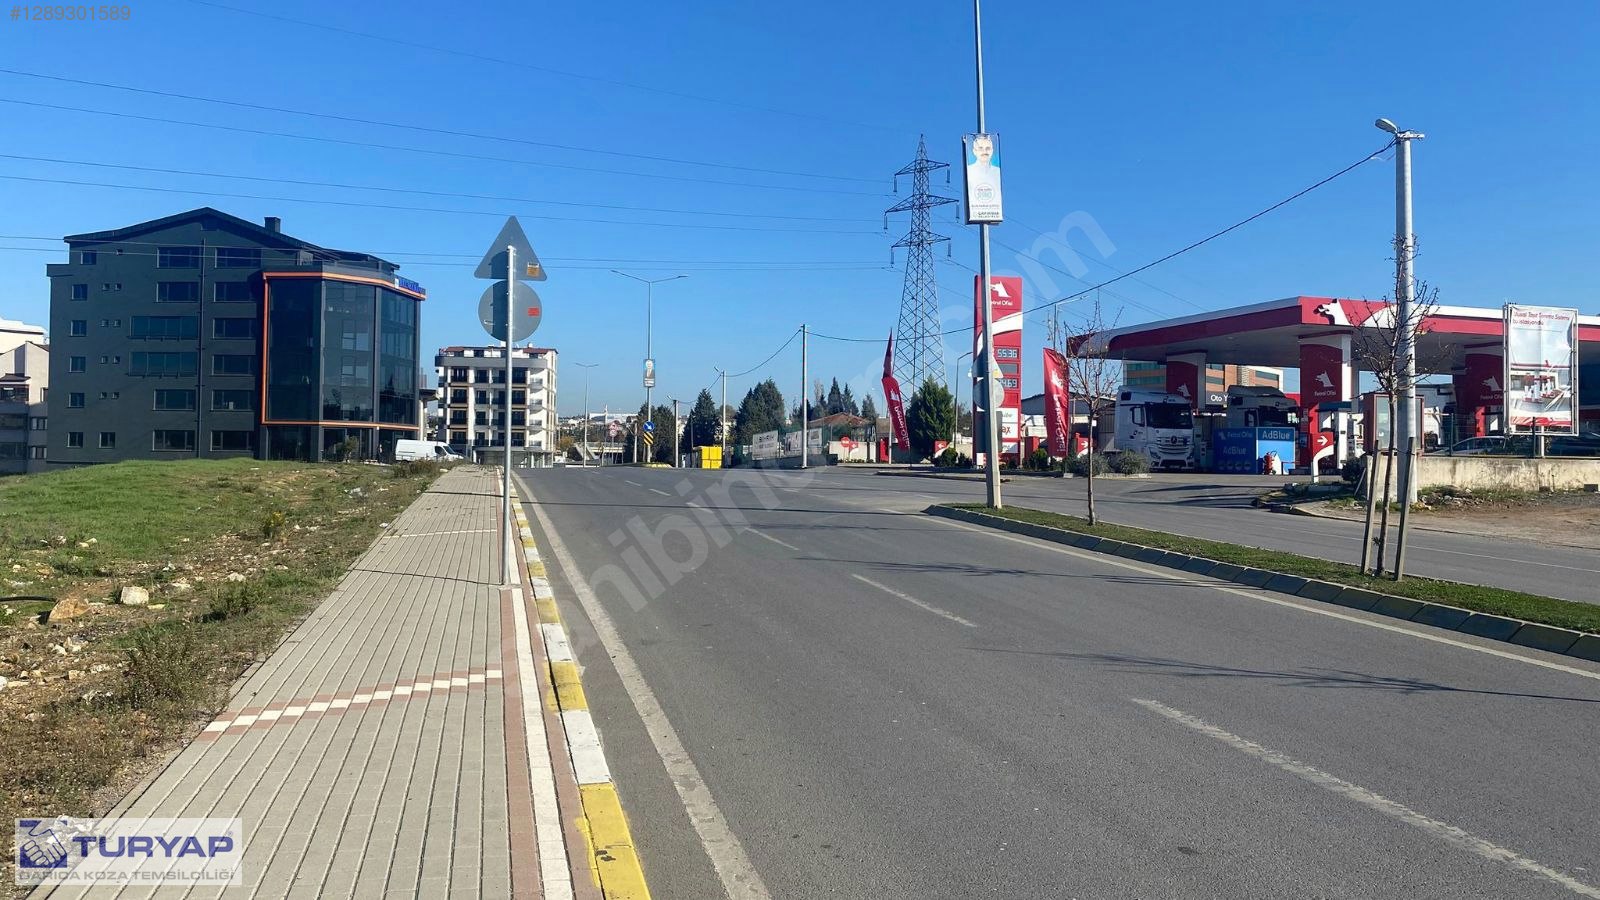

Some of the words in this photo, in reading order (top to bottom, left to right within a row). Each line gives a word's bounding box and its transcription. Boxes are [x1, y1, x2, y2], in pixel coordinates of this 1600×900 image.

[1210, 394, 1223, 402] Oto
[1262, 430, 1290, 440] AdBlue
[1222, 446, 1246, 455] AdBlue
